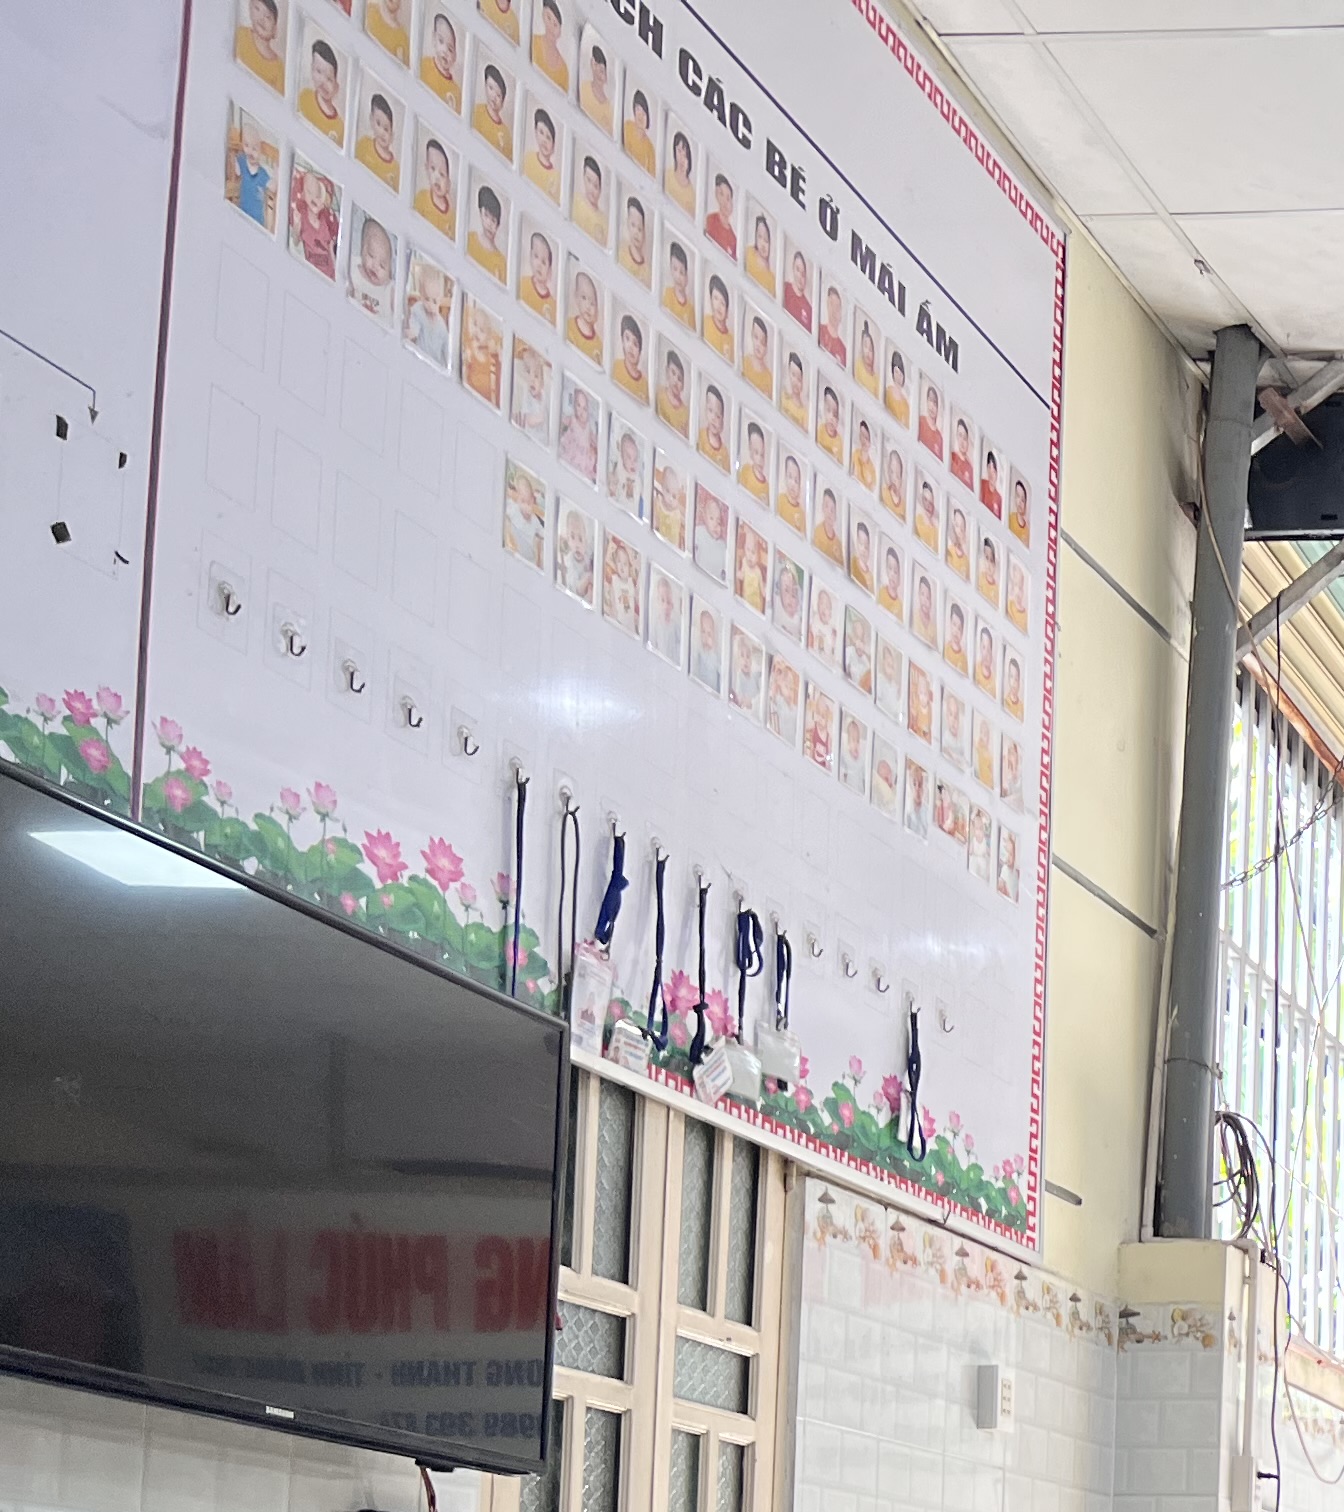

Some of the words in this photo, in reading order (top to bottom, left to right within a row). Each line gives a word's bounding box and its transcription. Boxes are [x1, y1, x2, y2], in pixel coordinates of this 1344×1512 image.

[678, 47, 753, 150] CÁC
[766, 137, 806, 211] BÉ
[851, 229, 906, 317] MÁI
